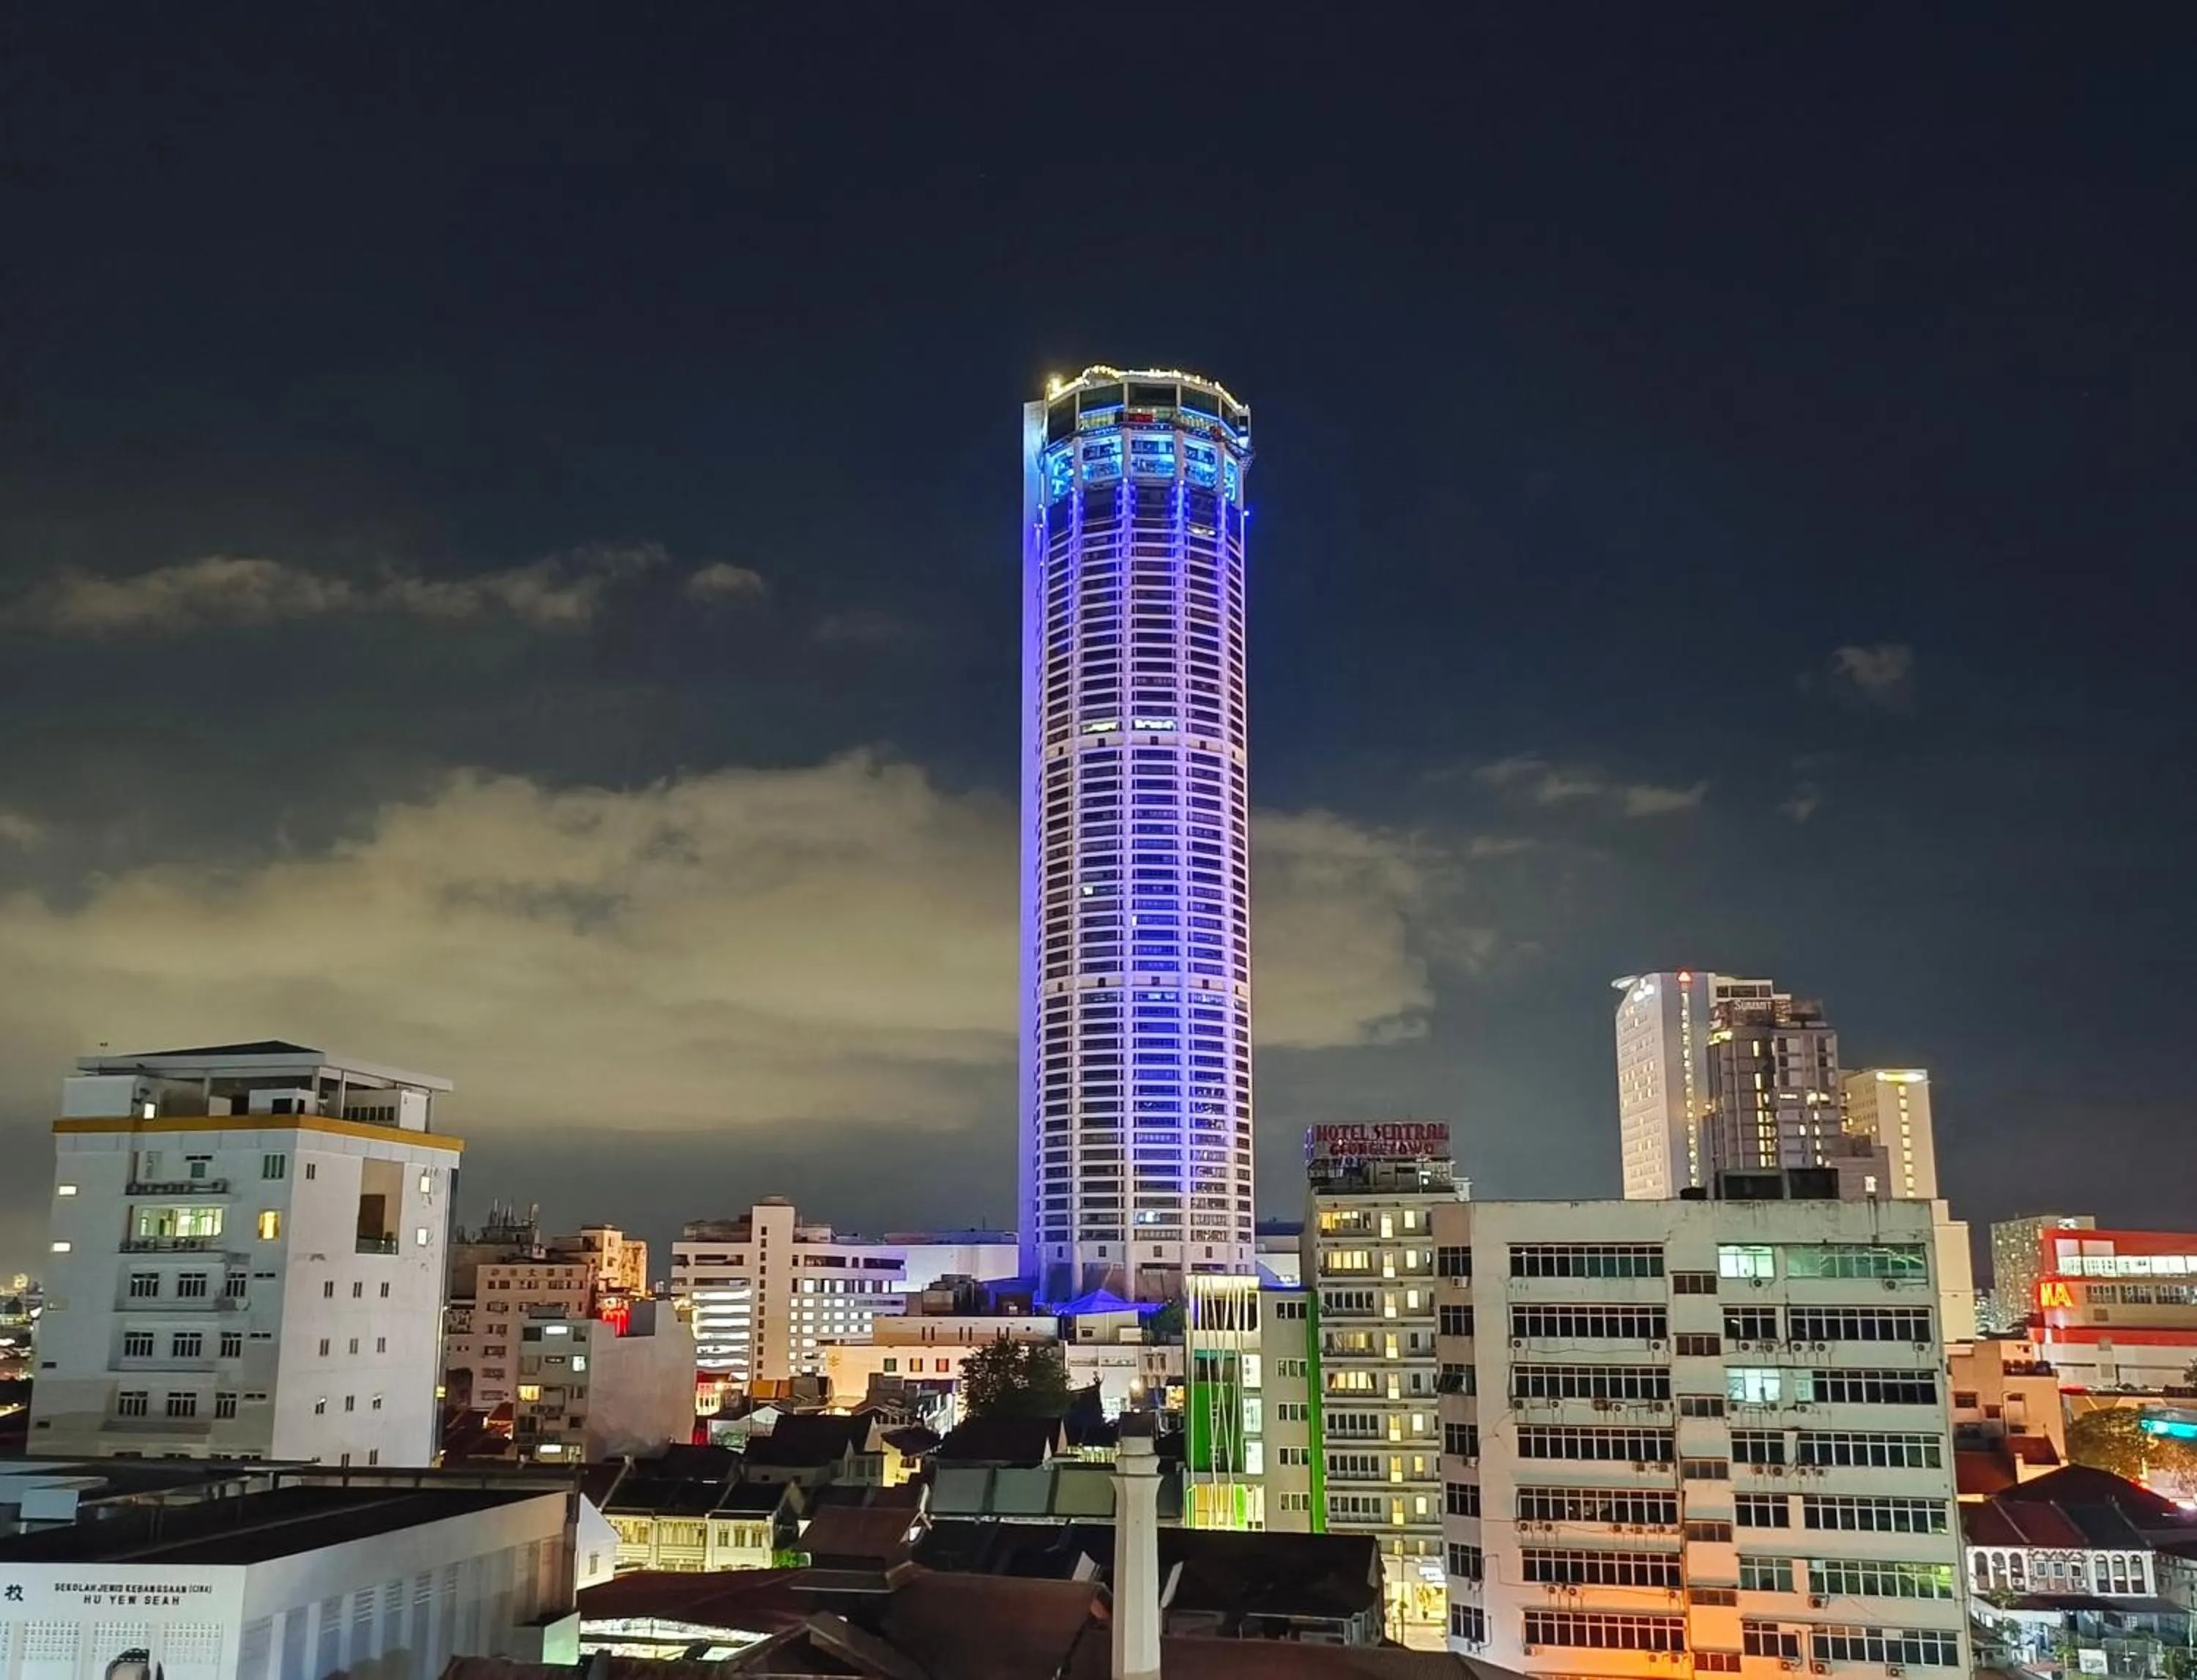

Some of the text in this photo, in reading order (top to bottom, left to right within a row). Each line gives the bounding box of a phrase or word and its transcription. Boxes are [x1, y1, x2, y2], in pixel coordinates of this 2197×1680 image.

[1316, 1123, 1449, 1141] HOTEL SENTRAL
[4, 1584, 24, 1602] 校
[55, 1583, 97, 1592] SEKOLAH
[83, 1595, 179, 1605] HU YEW SEAH
